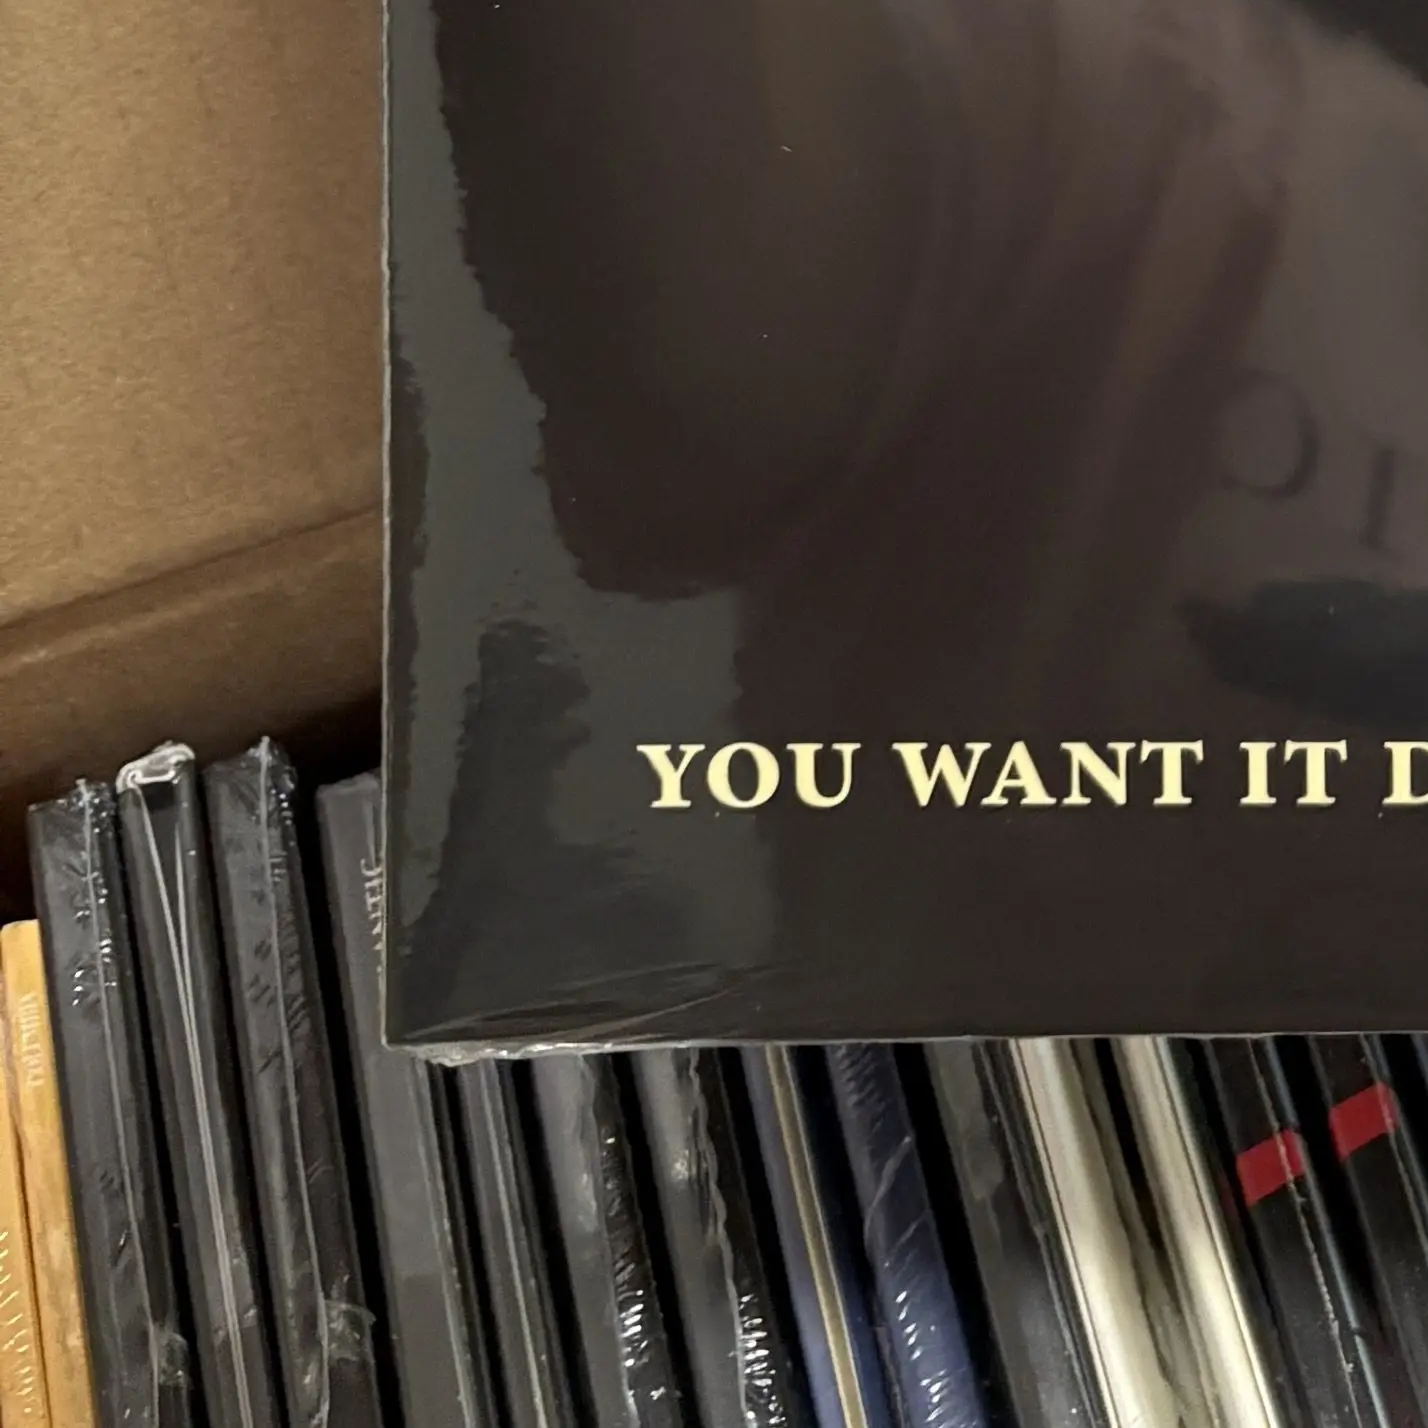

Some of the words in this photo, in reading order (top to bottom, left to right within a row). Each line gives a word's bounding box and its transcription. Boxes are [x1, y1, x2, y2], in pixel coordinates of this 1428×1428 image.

[636, 742, 862, 809] YOU
[892, 739, 1204, 807] WANT
[1239, 739, 1348, 805] IT
